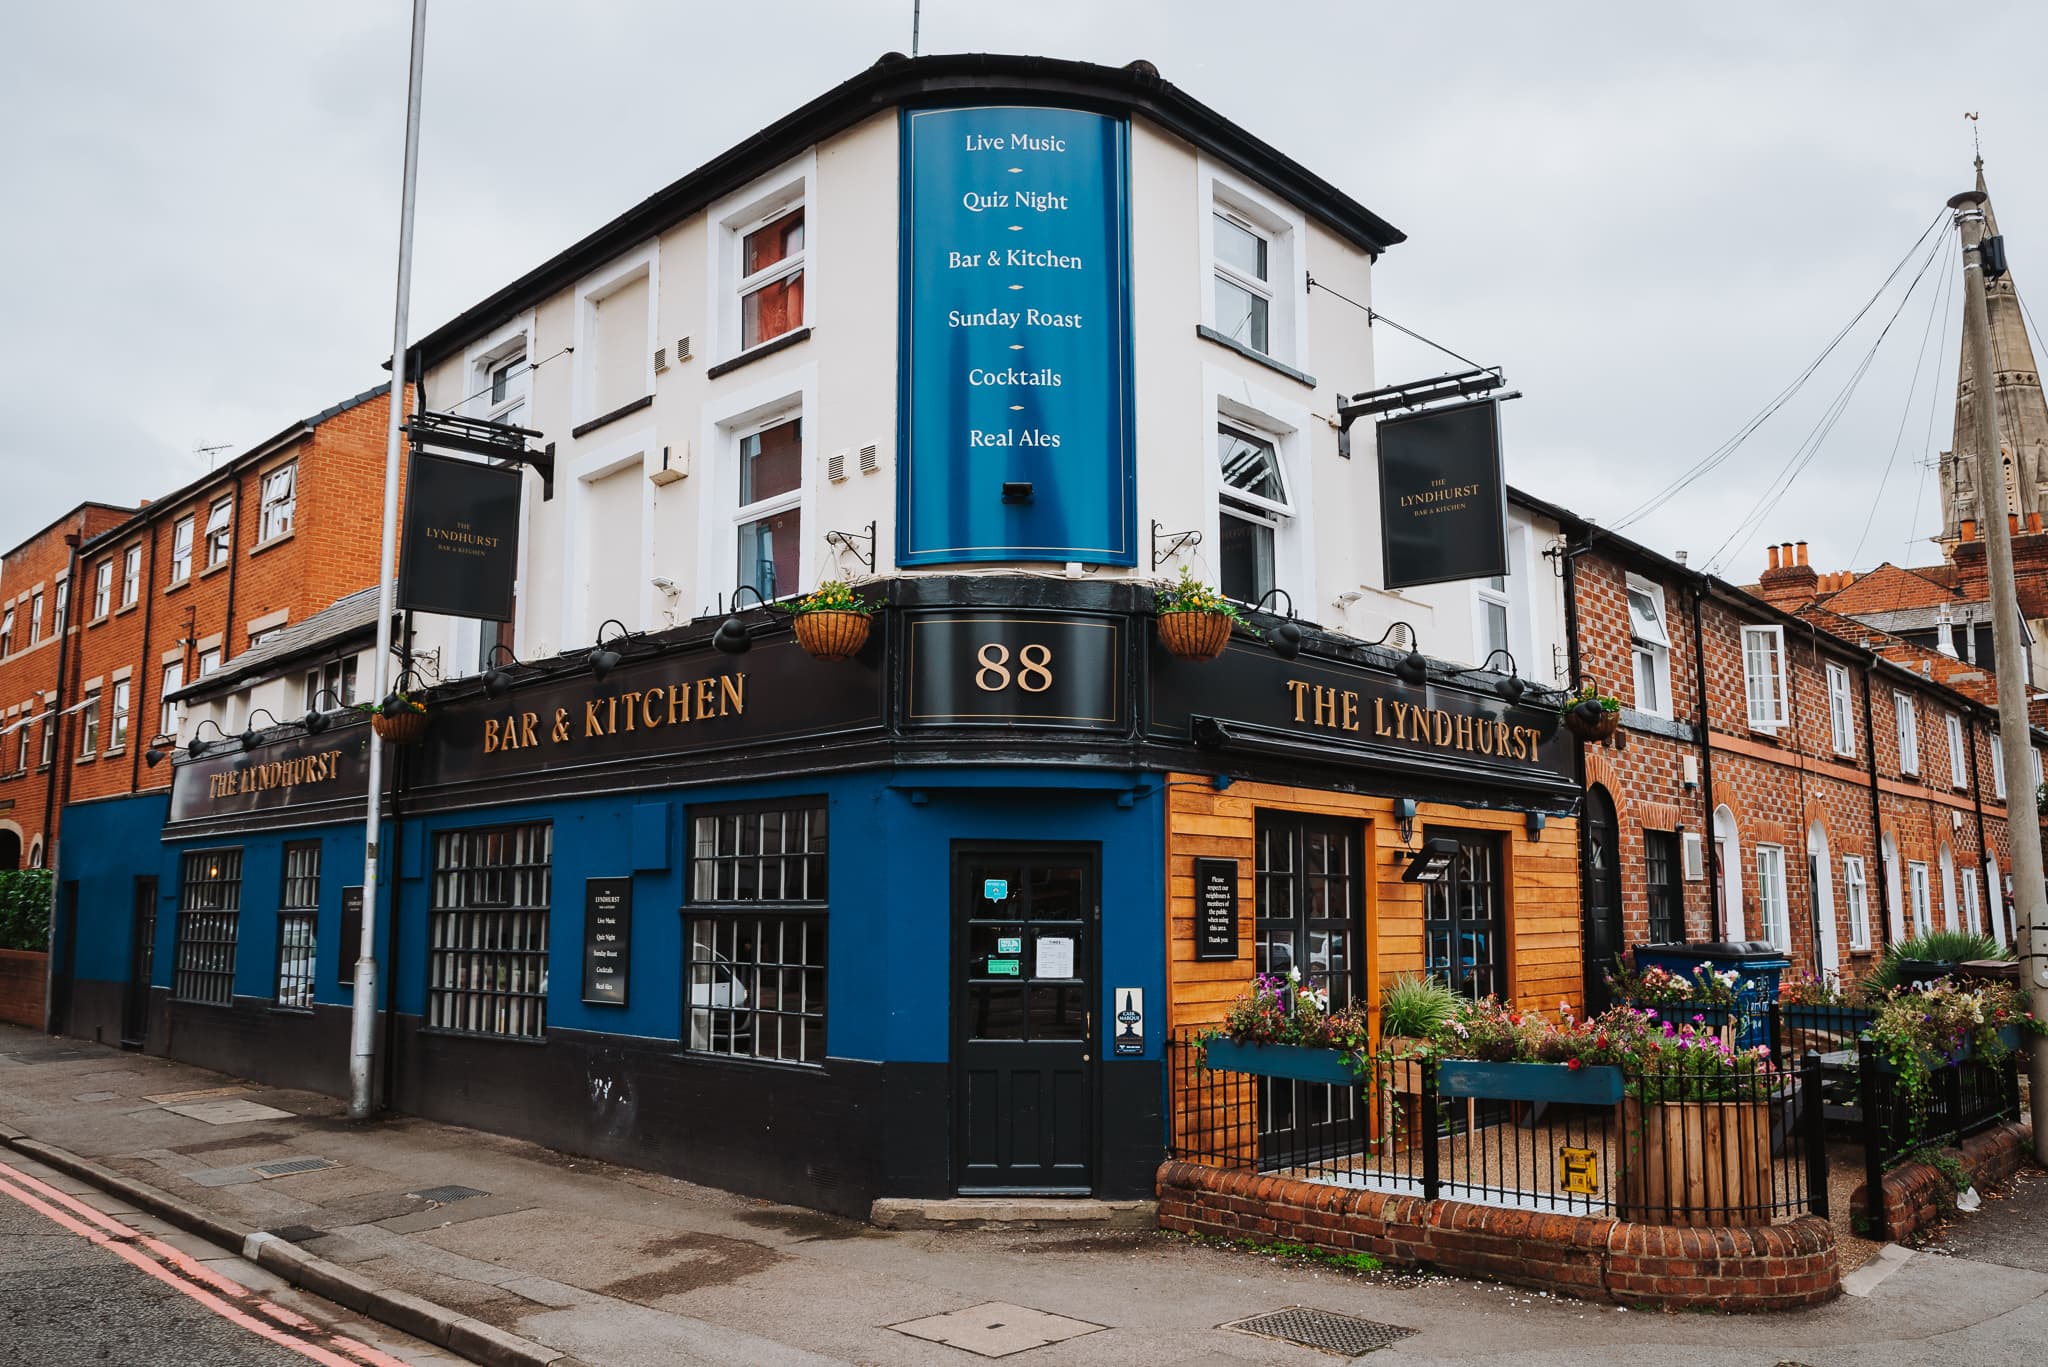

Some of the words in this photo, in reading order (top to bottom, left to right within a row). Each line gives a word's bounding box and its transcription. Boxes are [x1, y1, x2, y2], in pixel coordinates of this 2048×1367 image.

[966, 134, 1004, 151] Live
[1010, 133, 1066, 152] Music
[963, 192, 1009, 212] Quiz
[1015, 192, 1068, 211] Night
[949, 252, 981, 269] Bar
[987, 250, 1001, 266] &
[1007, 249, 1082, 270] Kitchen
[948, 308, 1020, 329] Sunday
[1027, 309, 1082, 329] Roast
[969, 368, 1062, 387] Cocktails
[970, 429, 1013, 447] Real
[1019, 429, 1061, 447] Ales
[1401, 484, 1479, 506] LYNDHURST
[1414, 509, 1428, 517] BAR
[1436, 503, 1466, 513] KITCHEN
[457, 522, 471, 531] THE
[426, 527, 499, 548] LYNDHURST
[458, 547, 486, 556] KITCHEN
[974, 642, 1053, 692] 88
[482, 712, 539, 754] BAR
[551, 707, 571, 742] &
[583, 672, 746, 738] KITCHEN
[1287, 679, 1360, 732] THE
[1374, 697, 1541, 762] LYNDHURST
[208, 770, 237, 799] THE
[240, 750, 342, 794] LYNDHURST
